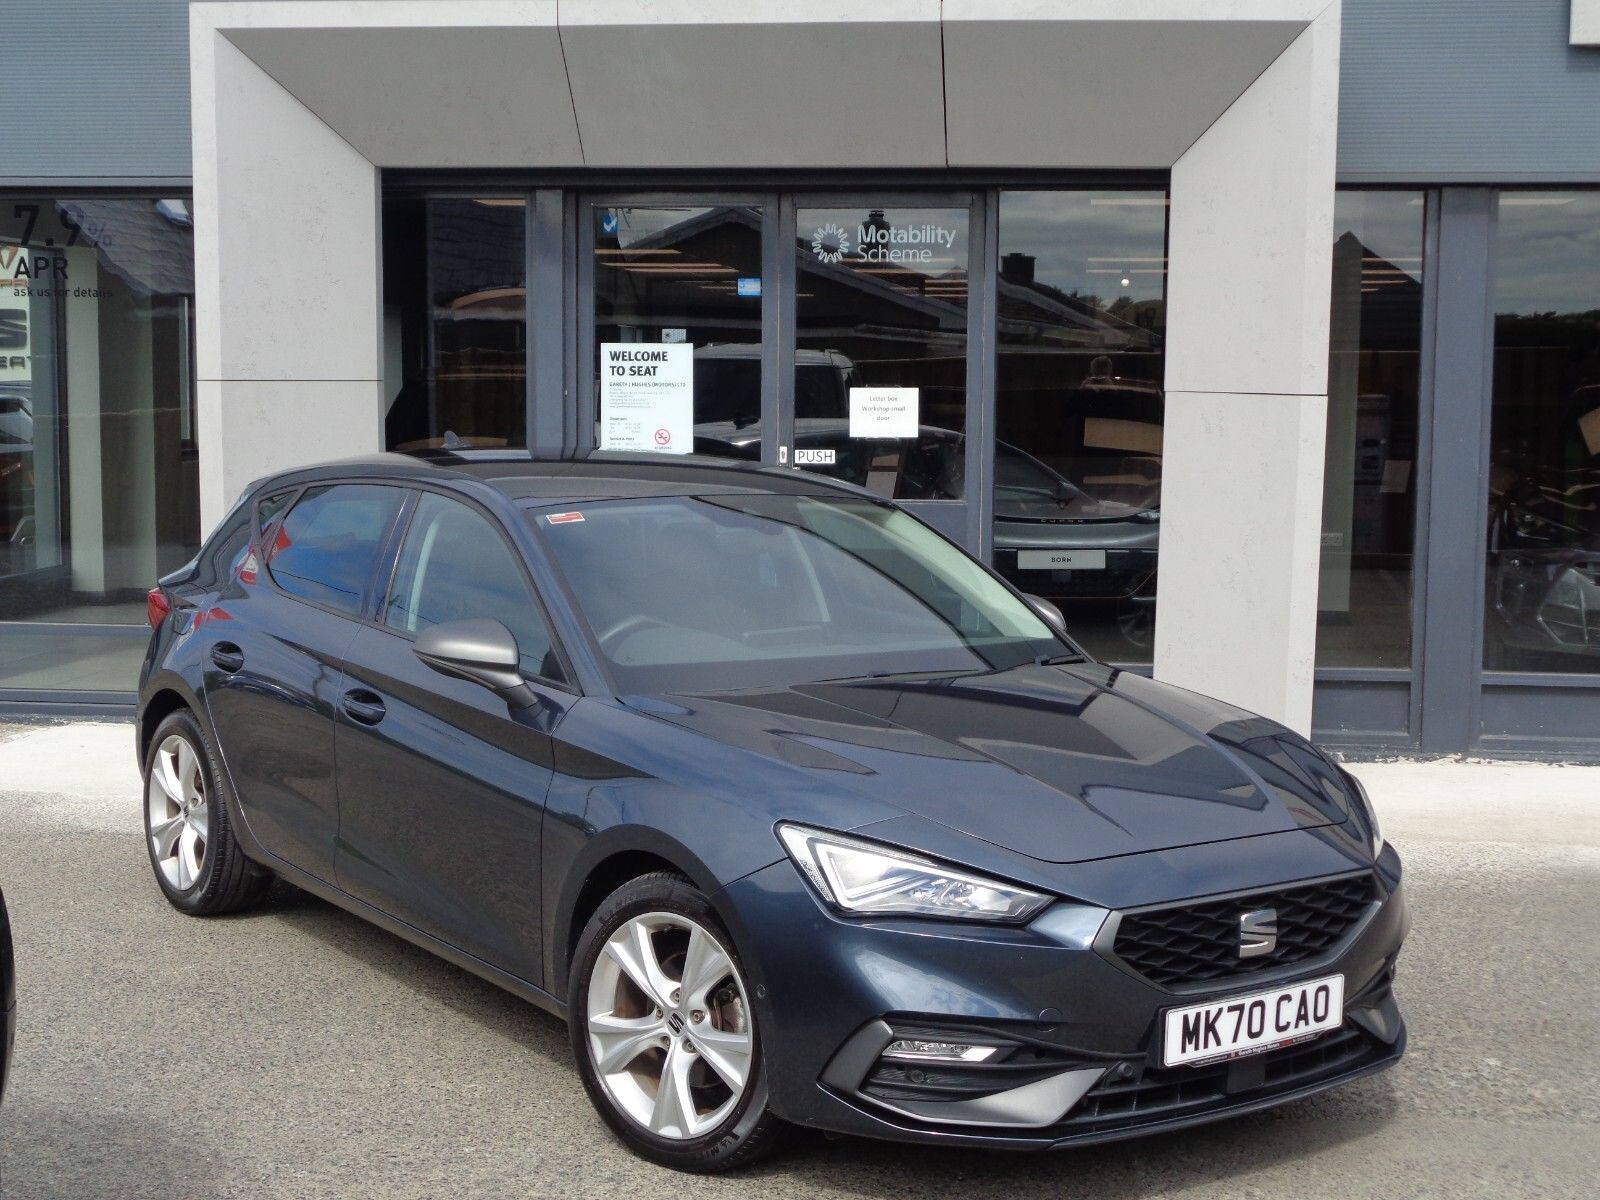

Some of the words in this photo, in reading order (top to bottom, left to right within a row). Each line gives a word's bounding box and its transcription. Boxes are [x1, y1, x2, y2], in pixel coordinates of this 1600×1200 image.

[857, 224, 956, 248] Motability
[857, 245, 932, 262] Scheme
[14, 256, 68, 279] APR
[14, 286, 33, 297] ask
[37, 287, 50, 297] us
[609, 351, 668, 361] WELCOME
[609, 366, 626, 376] TO
[629, 366, 658, 376] SEAT
[798, 450, 833, 463] PUSH
[1180, 999, 1266, 1054] MK70
[1274, 984, 1330, 1034] CAO
